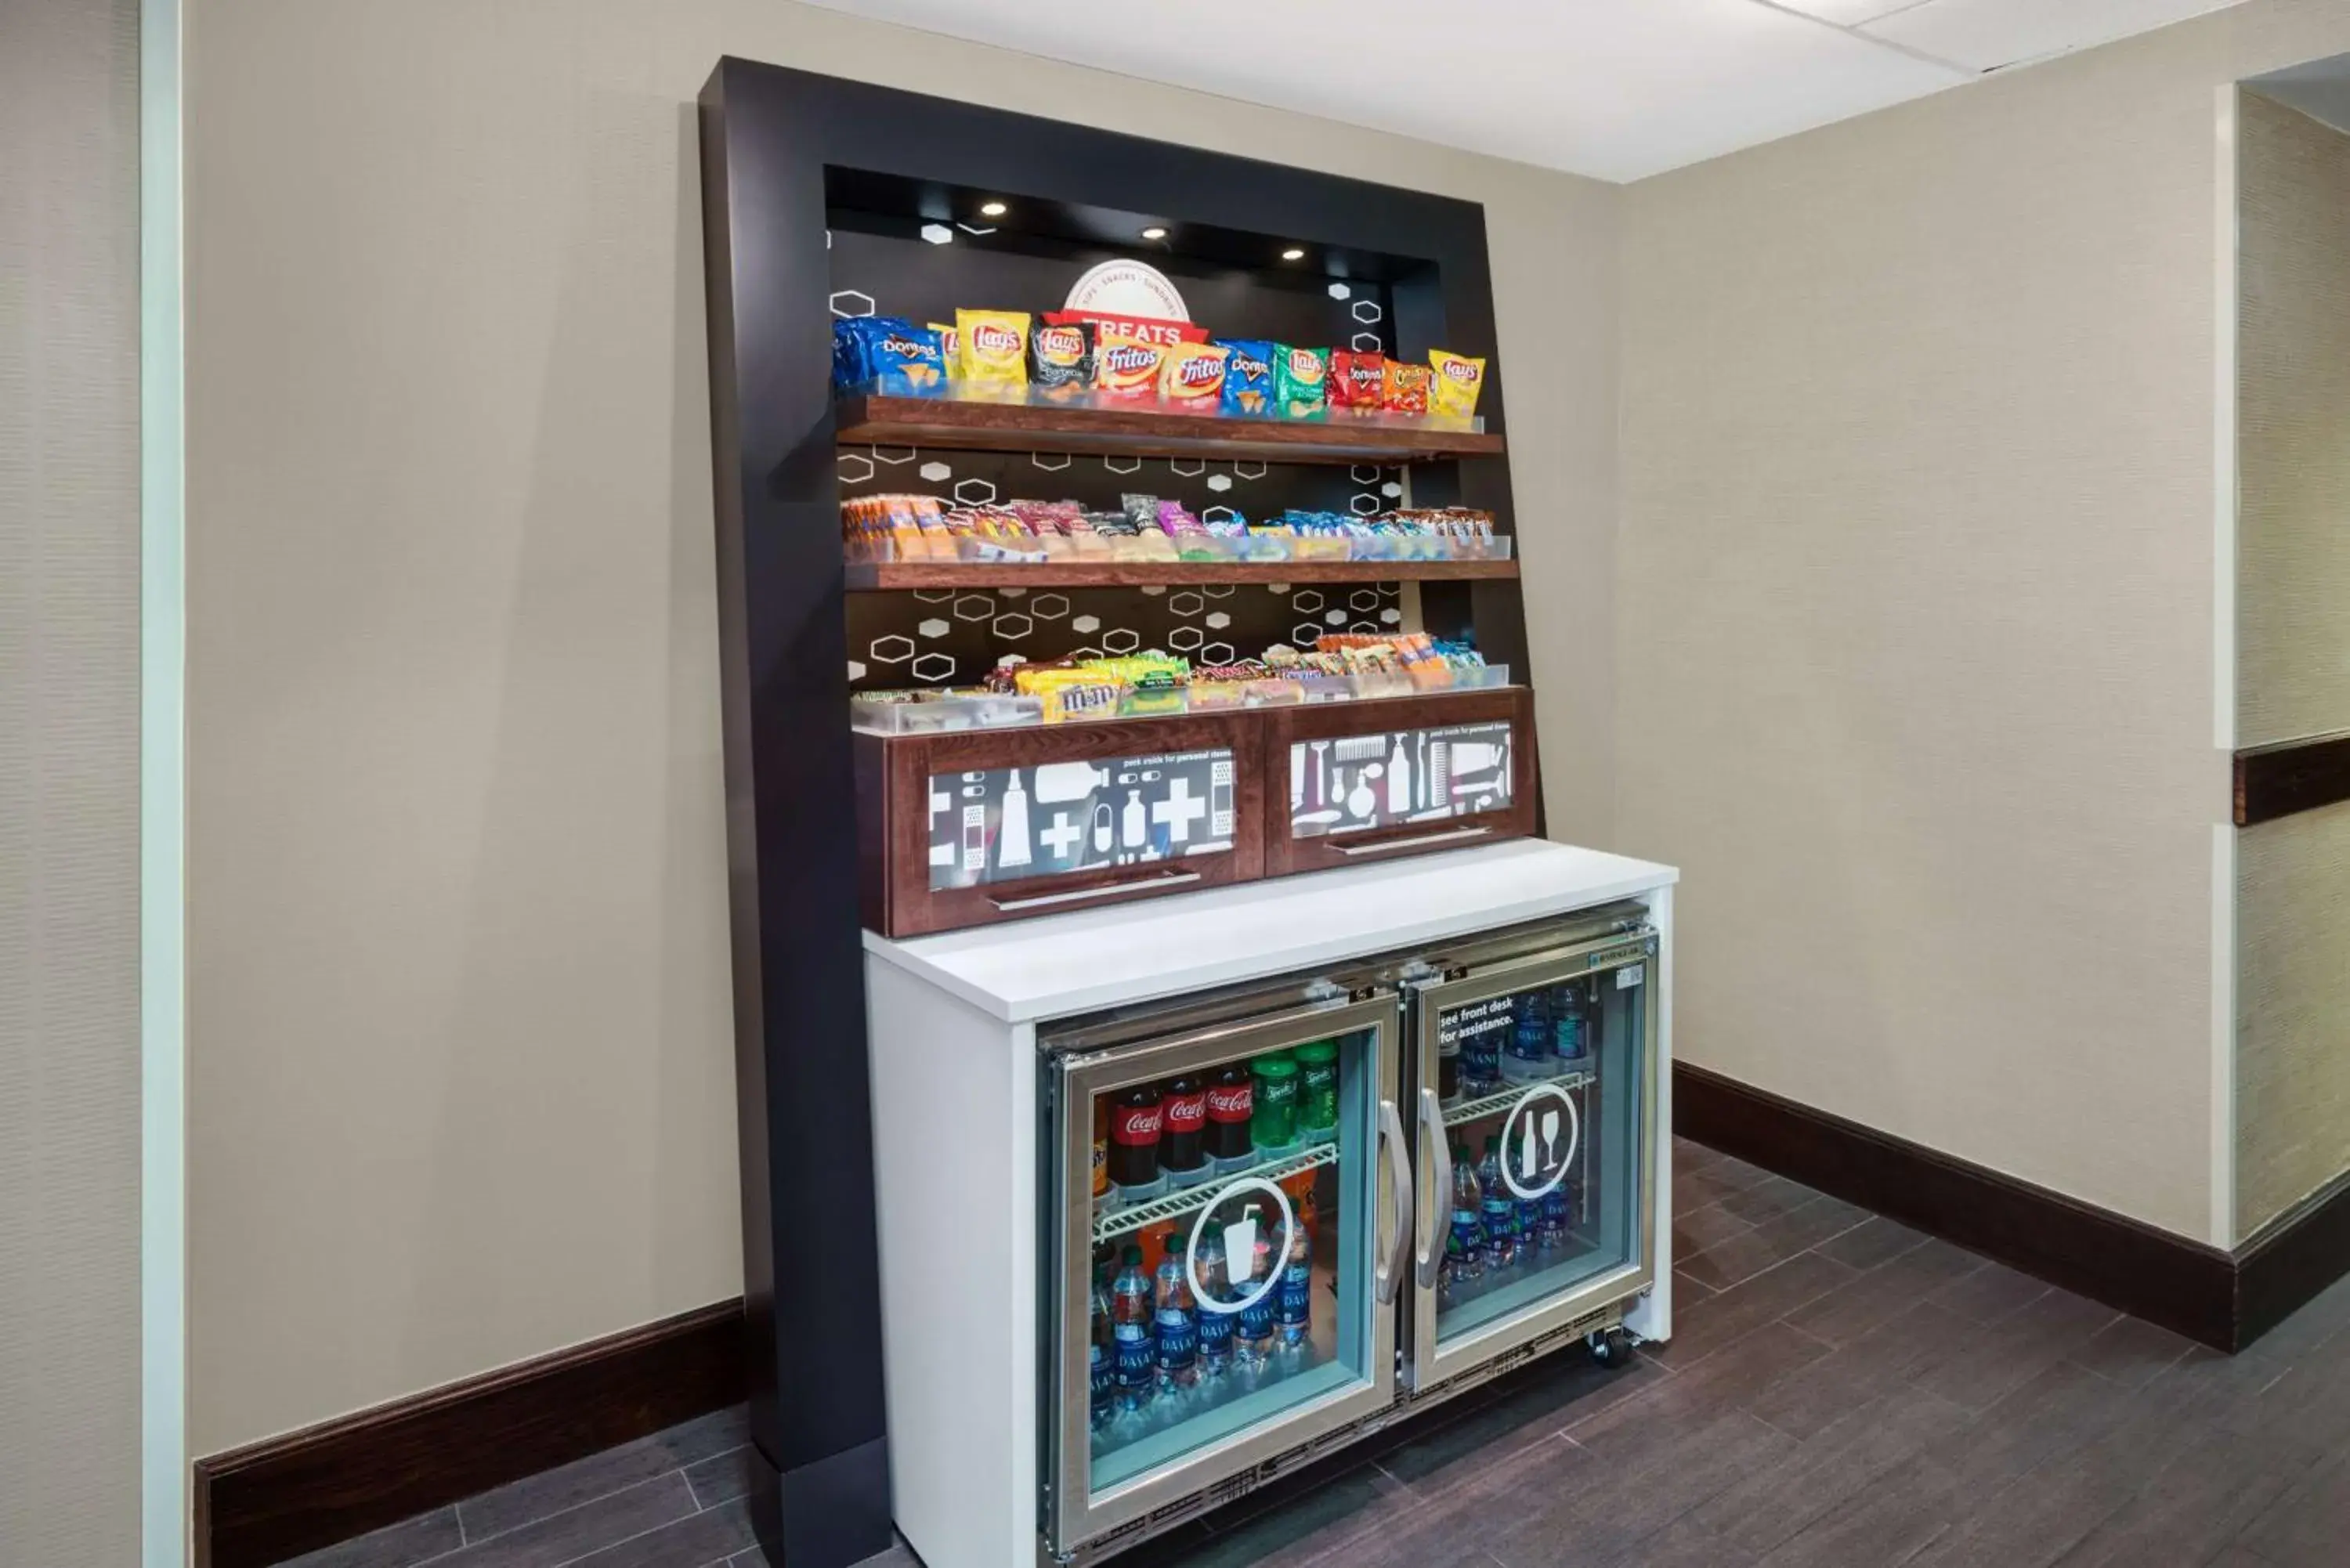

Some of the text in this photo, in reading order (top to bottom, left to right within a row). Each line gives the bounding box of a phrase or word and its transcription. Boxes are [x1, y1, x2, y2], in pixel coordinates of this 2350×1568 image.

[1107, 345, 1156, 371] Fritos
[1441, 996, 1513, 1028] see front desk
[1441, 1016, 1514, 1044] for assistance.
